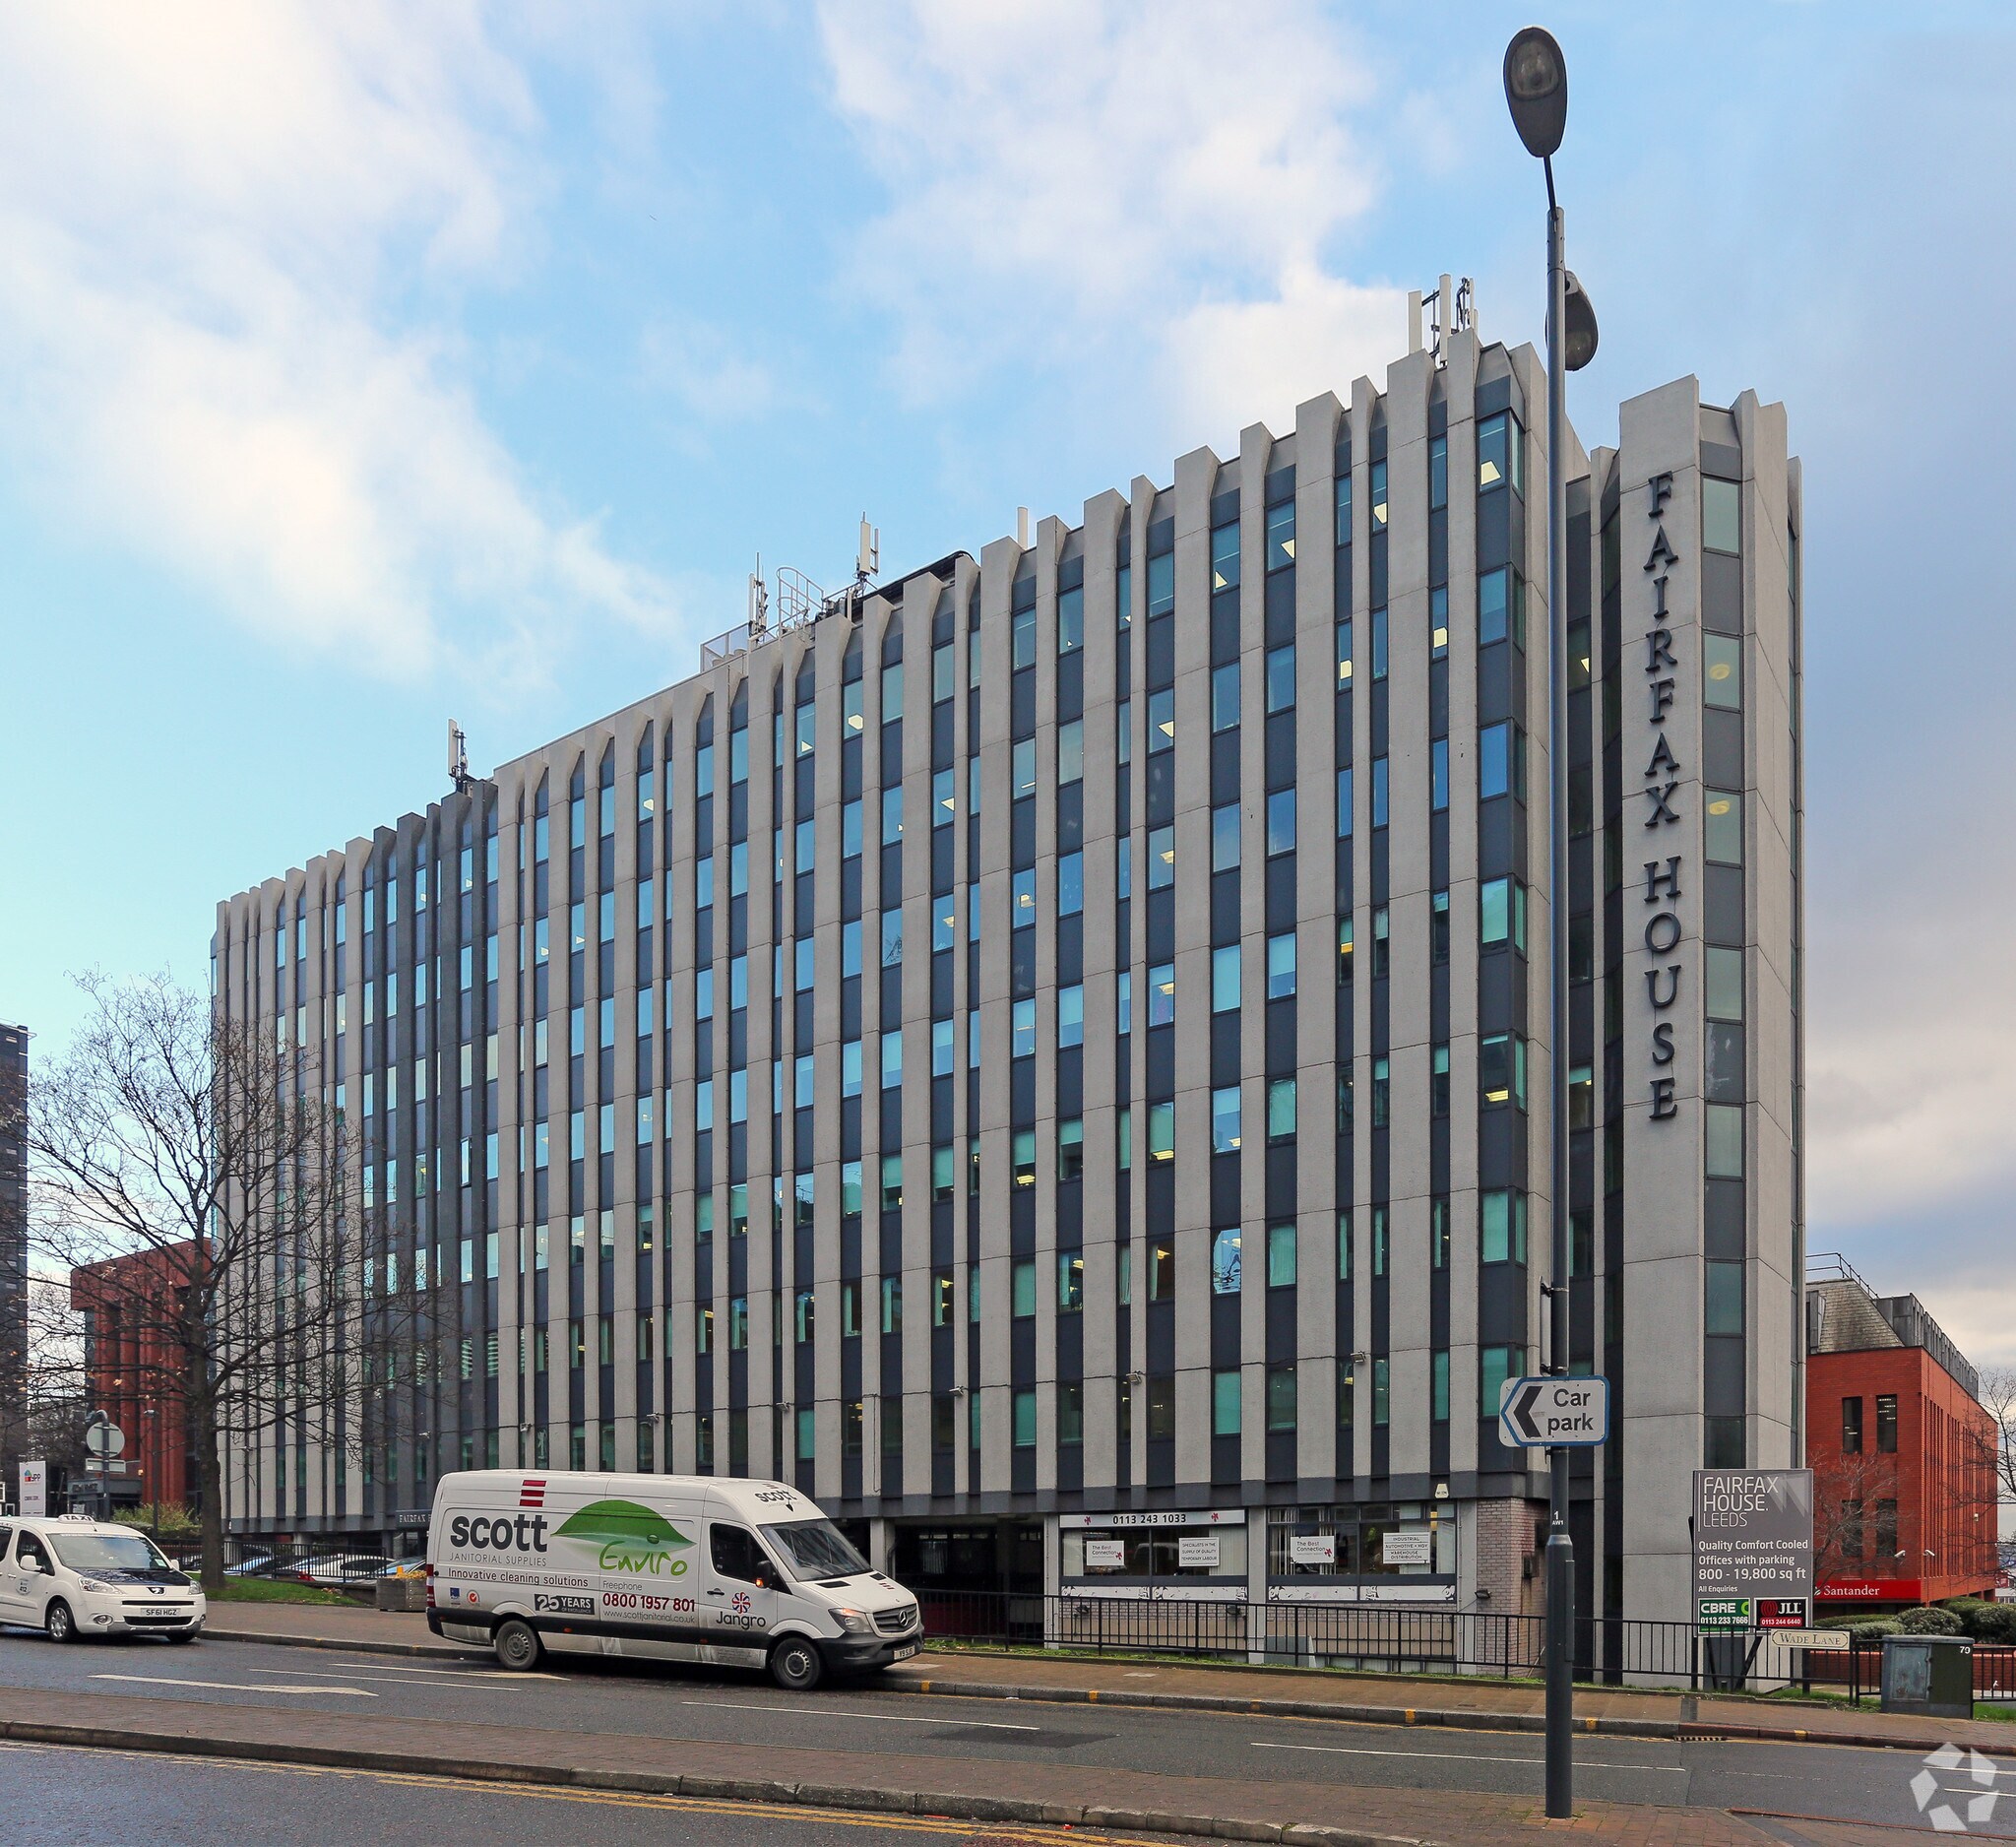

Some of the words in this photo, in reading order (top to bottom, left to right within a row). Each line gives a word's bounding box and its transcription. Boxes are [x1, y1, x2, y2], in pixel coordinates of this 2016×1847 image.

[1643, 471, 1679, 829] FAIRFAX
[1643, 855, 1682, 1119] HOUSE
[1553, 1388, 1591, 1408] Car
[1547, 1413, 1594, 1435] park
[1703, 1476, 1779, 1495] FAIRFAX
[1703, 1494, 1769, 1512] HOUSE.
[1112, 1514, 1137, 1525] 0113
[1140, 1514, 1159, 1524] 243
[1163, 1513, 1187, 1523] 1033
[1553, 1510, 1559, 1520] 1
[1703, 1512, 1748, 1528] LEEDS
[450, 1513, 548, 1553] scott
[1698, 1540, 1733, 1552] Quality
[1734, 1539, 1774, 1550] Comfort
[1776, 1539, 1808, 1550] Cooled
[449, 1552, 503, 1564] JANITORIAL
[505, 1555, 547, 1567] SUPPLIES
[598, 1540, 688, 1576] Enviro
[1698, 1555, 1733, 1565] Offices
[1734, 1555, 1757, 1564] with
[1758, 1554, 1796, 1566] parking
[448, 1567, 497, 1581] Innovative
[500, 1571, 540, 1586] cleaning
[543, 1575, 589, 1587] solutions
[1698, 1568, 1723, 1580] 800
[1733, 1567, 1776, 1581] 19,800
[1779, 1569, 1793, 1581] sq
[1796, 1567, 1806, 1579] ft
[602, 1580, 643, 1592] Freephone
[1708, 1584, 1738, 1594] Enquiries
[1823, 1584, 1880, 1596] Santander
[561, 1597, 591, 1609] YEARS
[602, 1592, 637, 1609] 0800
[640, 1595, 670, 1611] 1957
[672, 1597, 695, 1613] 801
[1700, 1602, 1736, 1614] CBRE
[1778, 1602, 1802, 1615] JLL
[716, 1611, 767, 1630] Jangro
